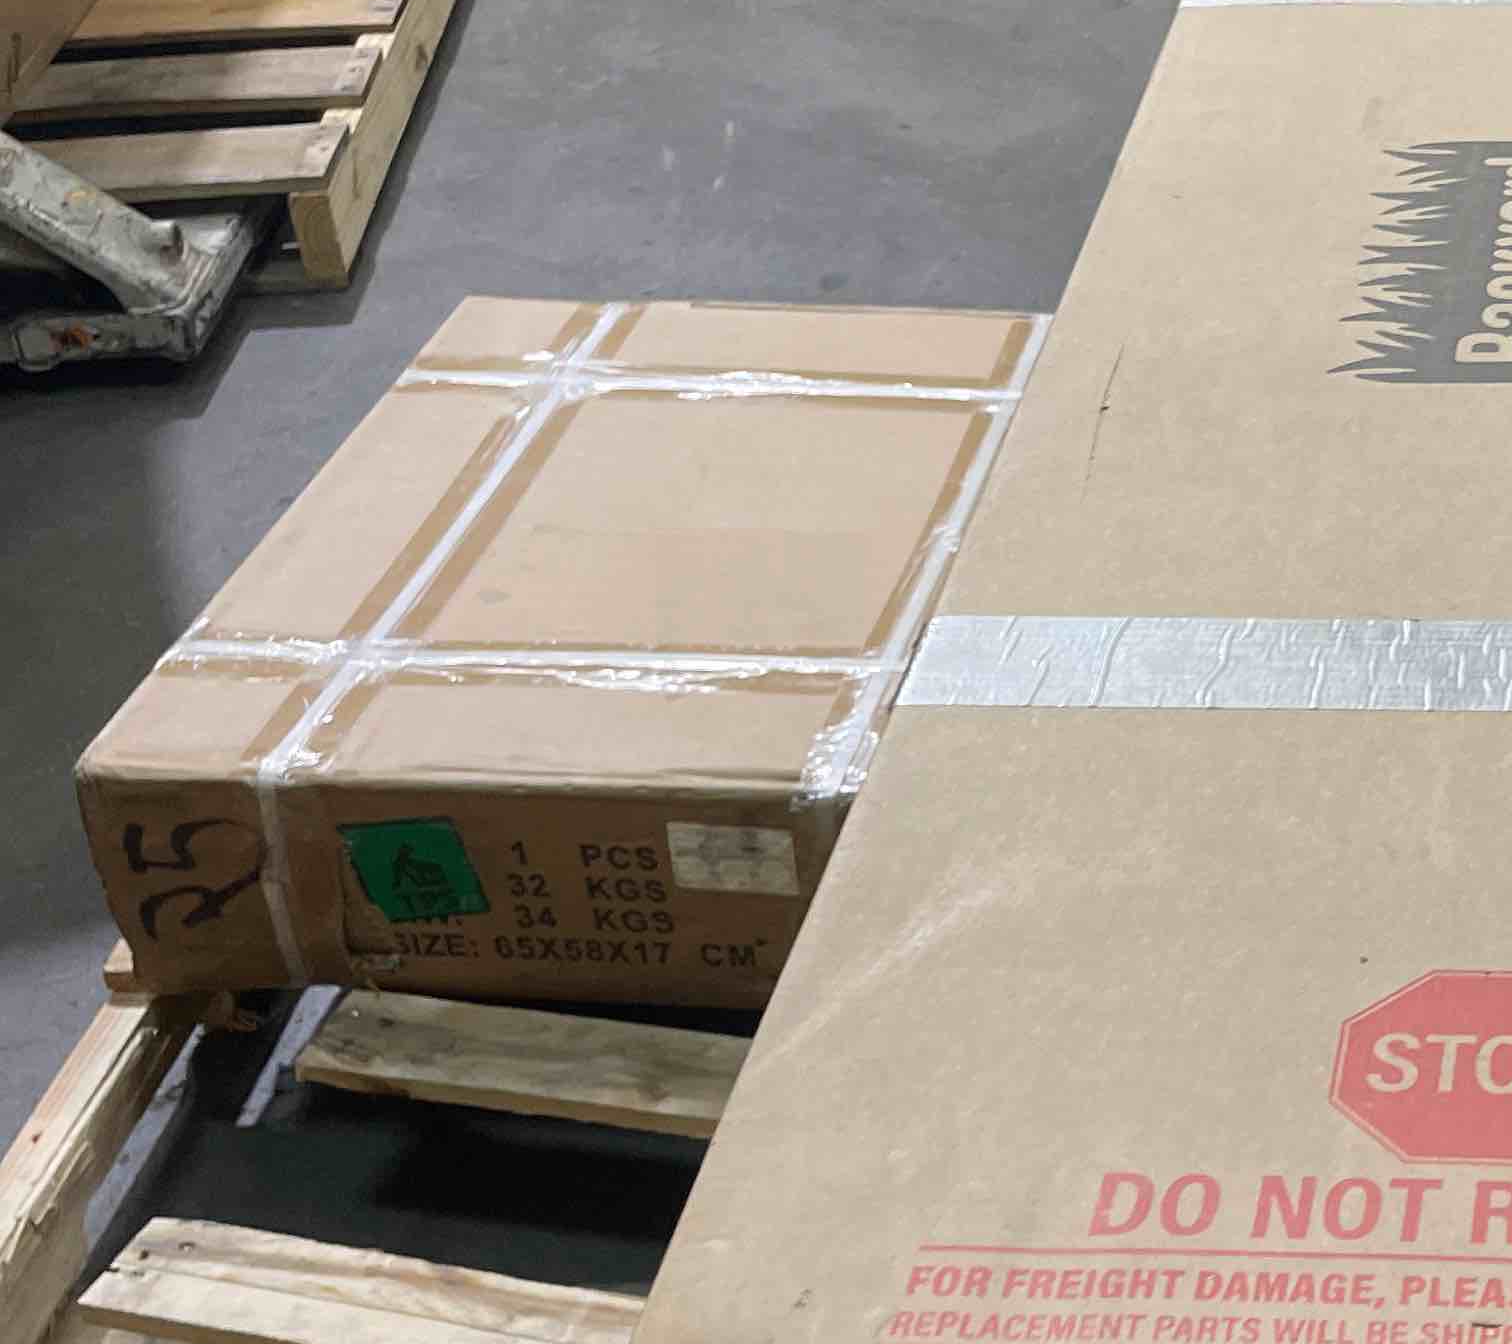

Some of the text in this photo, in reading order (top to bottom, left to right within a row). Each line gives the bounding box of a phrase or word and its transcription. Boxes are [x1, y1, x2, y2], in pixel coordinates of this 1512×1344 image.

[510, 841, 658, 871] 1 PCS
[507, 873, 667, 904] 32 KGS
[513, 904, 676, 935] 34 KGS
[1088, 1171, 1221, 1238] DO
[1250, 1174, 1443, 1243] NOT
[906, 1265, 992, 1298] FOR
[1002, 1267, 1186, 1301] FREIGHT
[1193, 1271, 1389, 1310] DAMAGE,
[889, 1310, 1147, 1342] REPLACEMENT
[1152, 1314, 1260, 1344] PARTS
